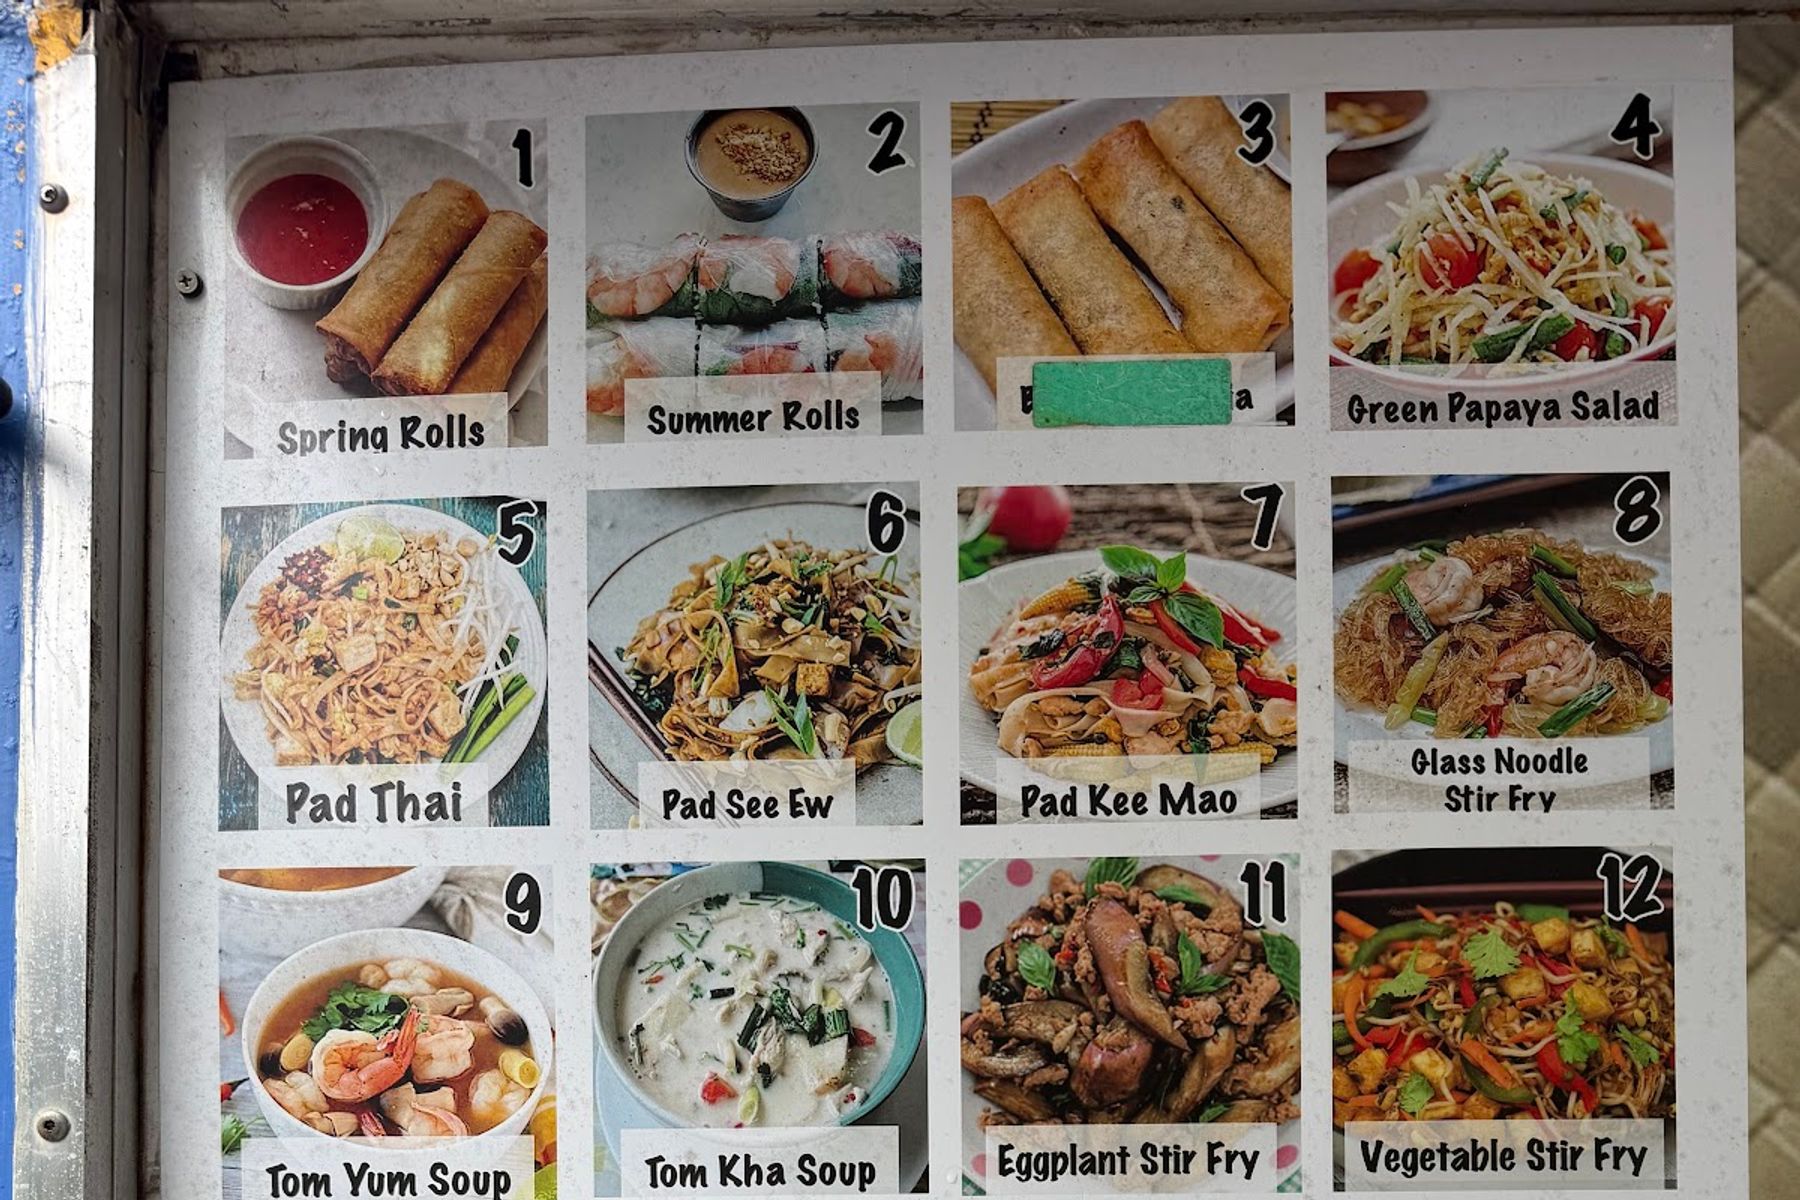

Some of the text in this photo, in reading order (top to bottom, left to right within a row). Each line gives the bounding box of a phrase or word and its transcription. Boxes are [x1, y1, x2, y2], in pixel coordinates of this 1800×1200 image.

[868, 111, 906, 173] 2
[1237, 102, 1275, 163] 3
[1612, 95, 1659, 157] 4
[512, 129, 534, 188] 1
[399, 413, 485, 450] Rolls
[647, 398, 860, 435] Summer Rolls
[1347, 389, 1659, 429] Green Papaya Salad
[498, 502, 536, 565] 5
[868, 492, 906, 554] 6
[1243, 484, 1283, 548] 7
[1615, 478, 1661, 543] 8
[1411, 746, 1589, 776] Glass Noodle
[286, 779, 462, 825] Pad Thai
[662, 787, 834, 821] Pad See Ew
[1021, 781, 1238, 818] Pad Kee Mao
[1444, 784, 1557, 814] Stir Fry
[505, 873, 540, 934] 9
[852, 869, 912, 930] 10
[1240, 861, 1284, 924] 11
[1599, 854, 1662, 919] 12
[265, 1163, 333, 1199] Tom
[342, 1162, 418, 1197] Yum
[644, 1153, 876, 1193] Tom Kha Soup
[998, 1140, 1260, 1183] Eggplant Stir Fry
[1360, 1136, 1649, 1179] Vegetable Stir Fry
